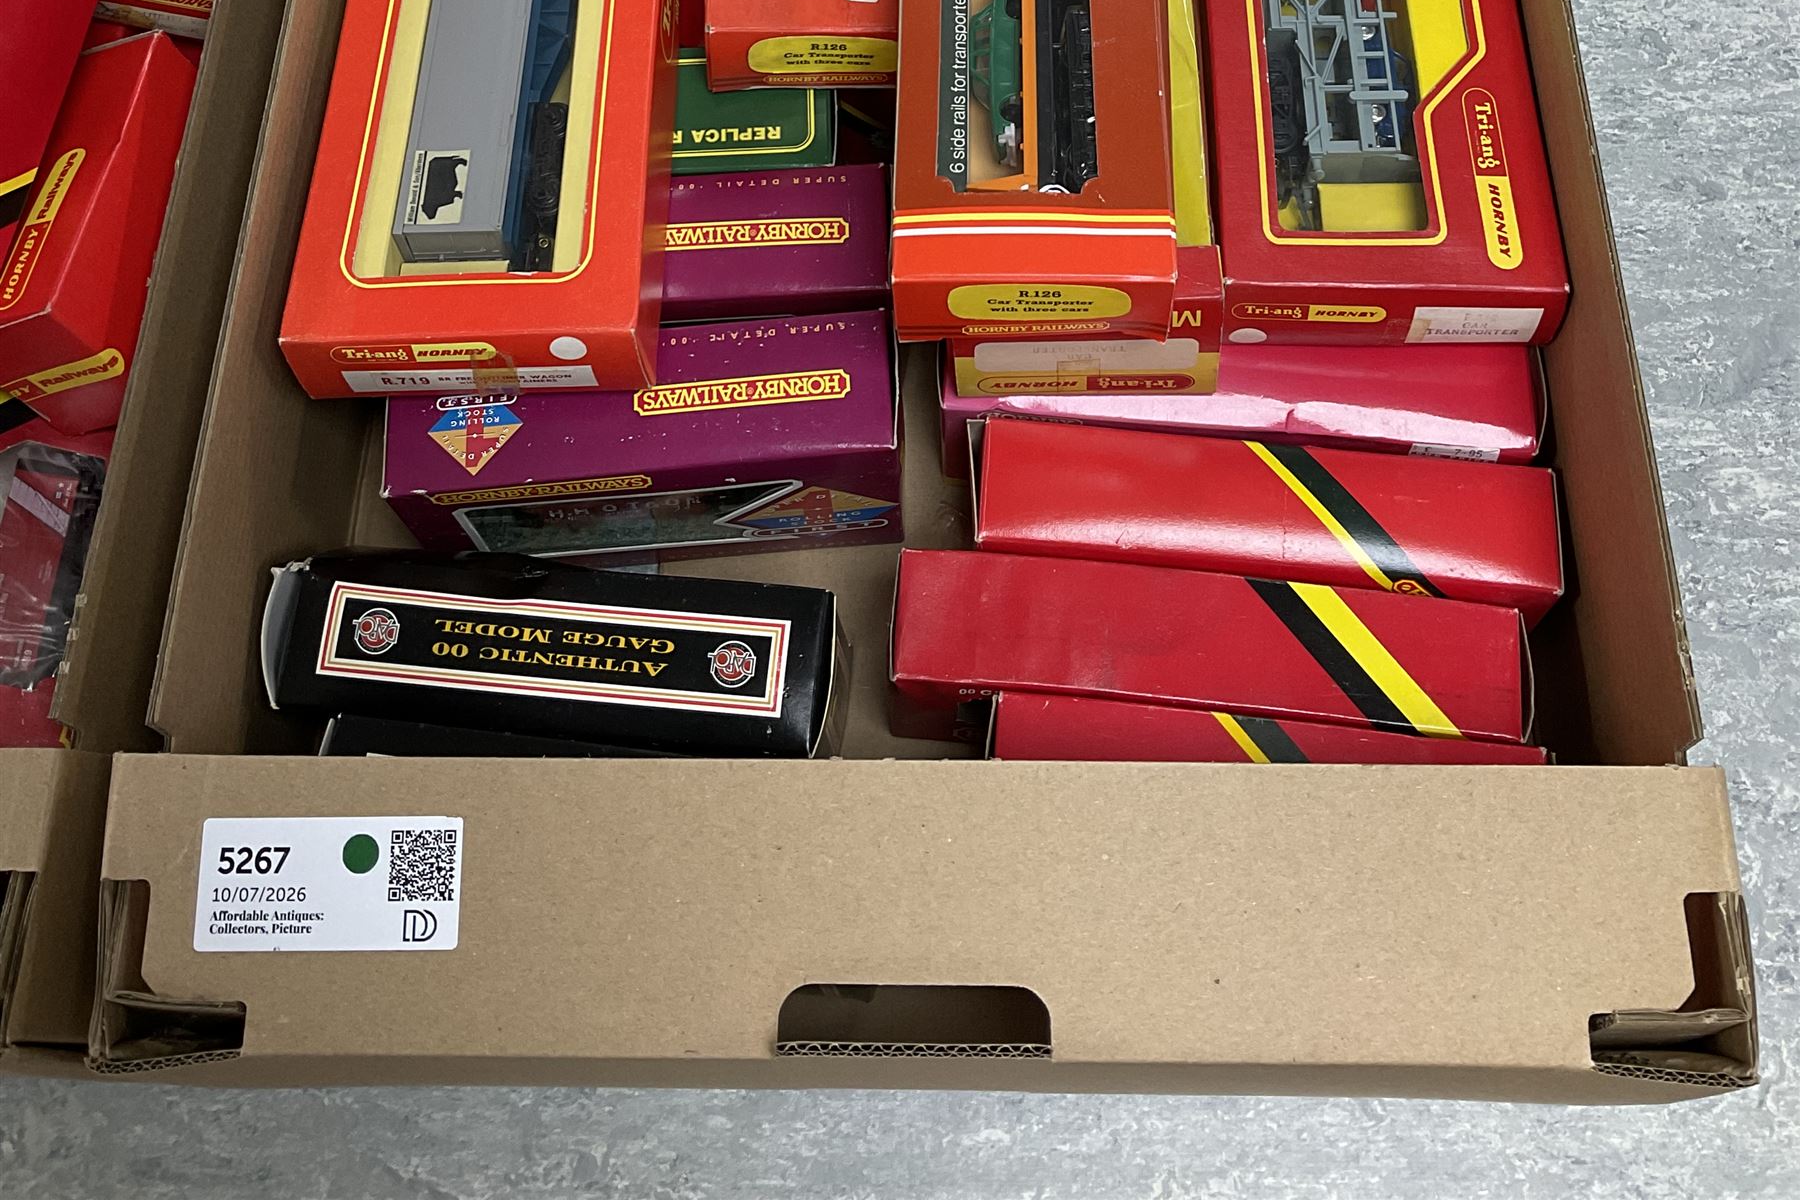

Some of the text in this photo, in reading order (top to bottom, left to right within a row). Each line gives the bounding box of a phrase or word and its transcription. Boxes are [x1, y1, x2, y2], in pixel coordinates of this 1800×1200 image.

[950, 71, 966, 92] for
[950, 95, 966, 126] rails
[691, 126, 782, 144] REPLICA
[950, 128, 966, 160] side
[950, 162, 965, 174] 6
[716, 178, 780, 188] DETAIL
[792, 176, 846, 184] SUPER
[1474, 102, 1512, 258] Tri-ang HORNBY
[3, 151, 78, 300] HORNBY Railways
[665, 222, 840, 244] HORNBY RAILWAY
[1244, 306, 1378, 318] Tri-ang HORNBY
[790, 322, 846, 334] SUPER
[969, 322, 1105, 334] HORNBY RAILWAYS
[342, 348, 488, 361] Tri-ang HORNBY
[38, 354, 120, 388] Railways
[381, 376, 430, 386] R.719
[991, 380, 1079, 389] HORNBY
[644, 374, 841, 409] HORNBY RAILWAYS
[445, 395, 508, 406] FIRST
[450, 416, 500, 427] ROLLING
[458, 408, 494, 418] STOCK
[440, 478, 644, 502] HORNBY RAILWAYS
[353, 616, 400, 644] DAPOL
[434, 618, 675, 654] GAUGE MODEL
[479, 647, 669, 677] AUTHENTIC
[708, 650, 756, 678] DAPOL
[217, 846, 291, 875] 5267
[212, 886, 307, 902] 10/07/2026
[210, 910, 324, 924] Affordable Antiques:
[271, 924, 313, 935] Picture
